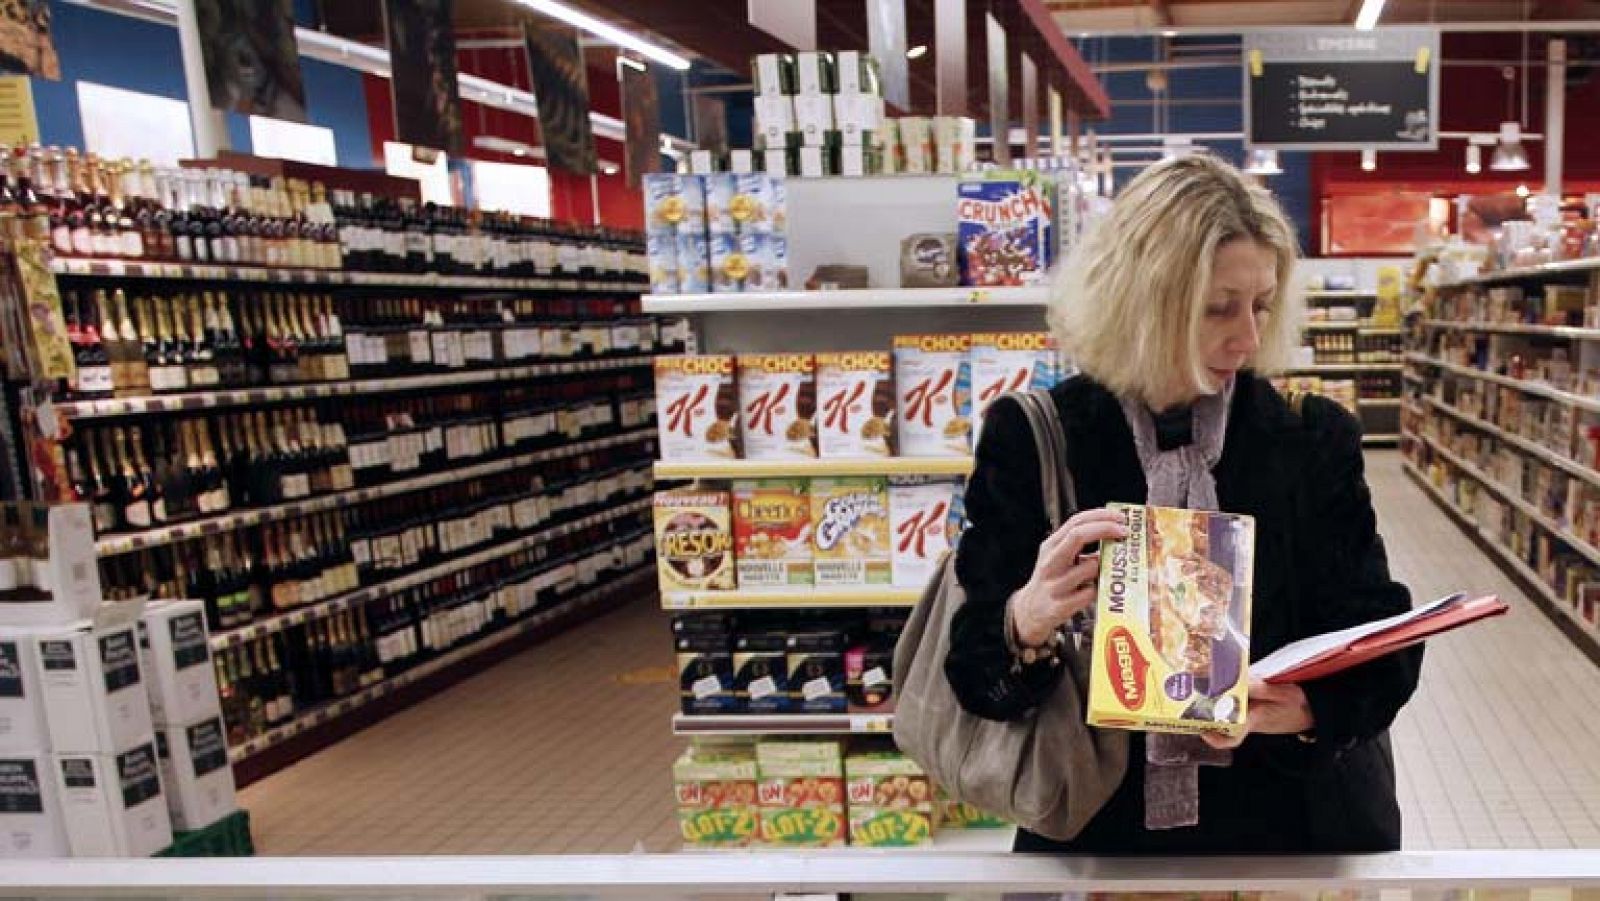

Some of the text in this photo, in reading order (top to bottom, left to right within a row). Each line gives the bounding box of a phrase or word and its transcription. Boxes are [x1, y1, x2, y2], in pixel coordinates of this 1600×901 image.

[958, 187, 1040, 224] CRUNCH
[763, 354, 814, 372] CHOC
[841, 352, 891, 370] CHOC
[920, 334, 972, 352] CHOC
[997, 332, 1047, 350] CHOC
[682, 356, 733, 374] CHOC
[666, 383, 709, 437] K
[747, 382, 790, 435] K
[823, 380, 866, 433] K
[904, 368, 953, 428] K
[897, 502, 947, 558] K
[1108, 508, 1129, 613] MOUSS
